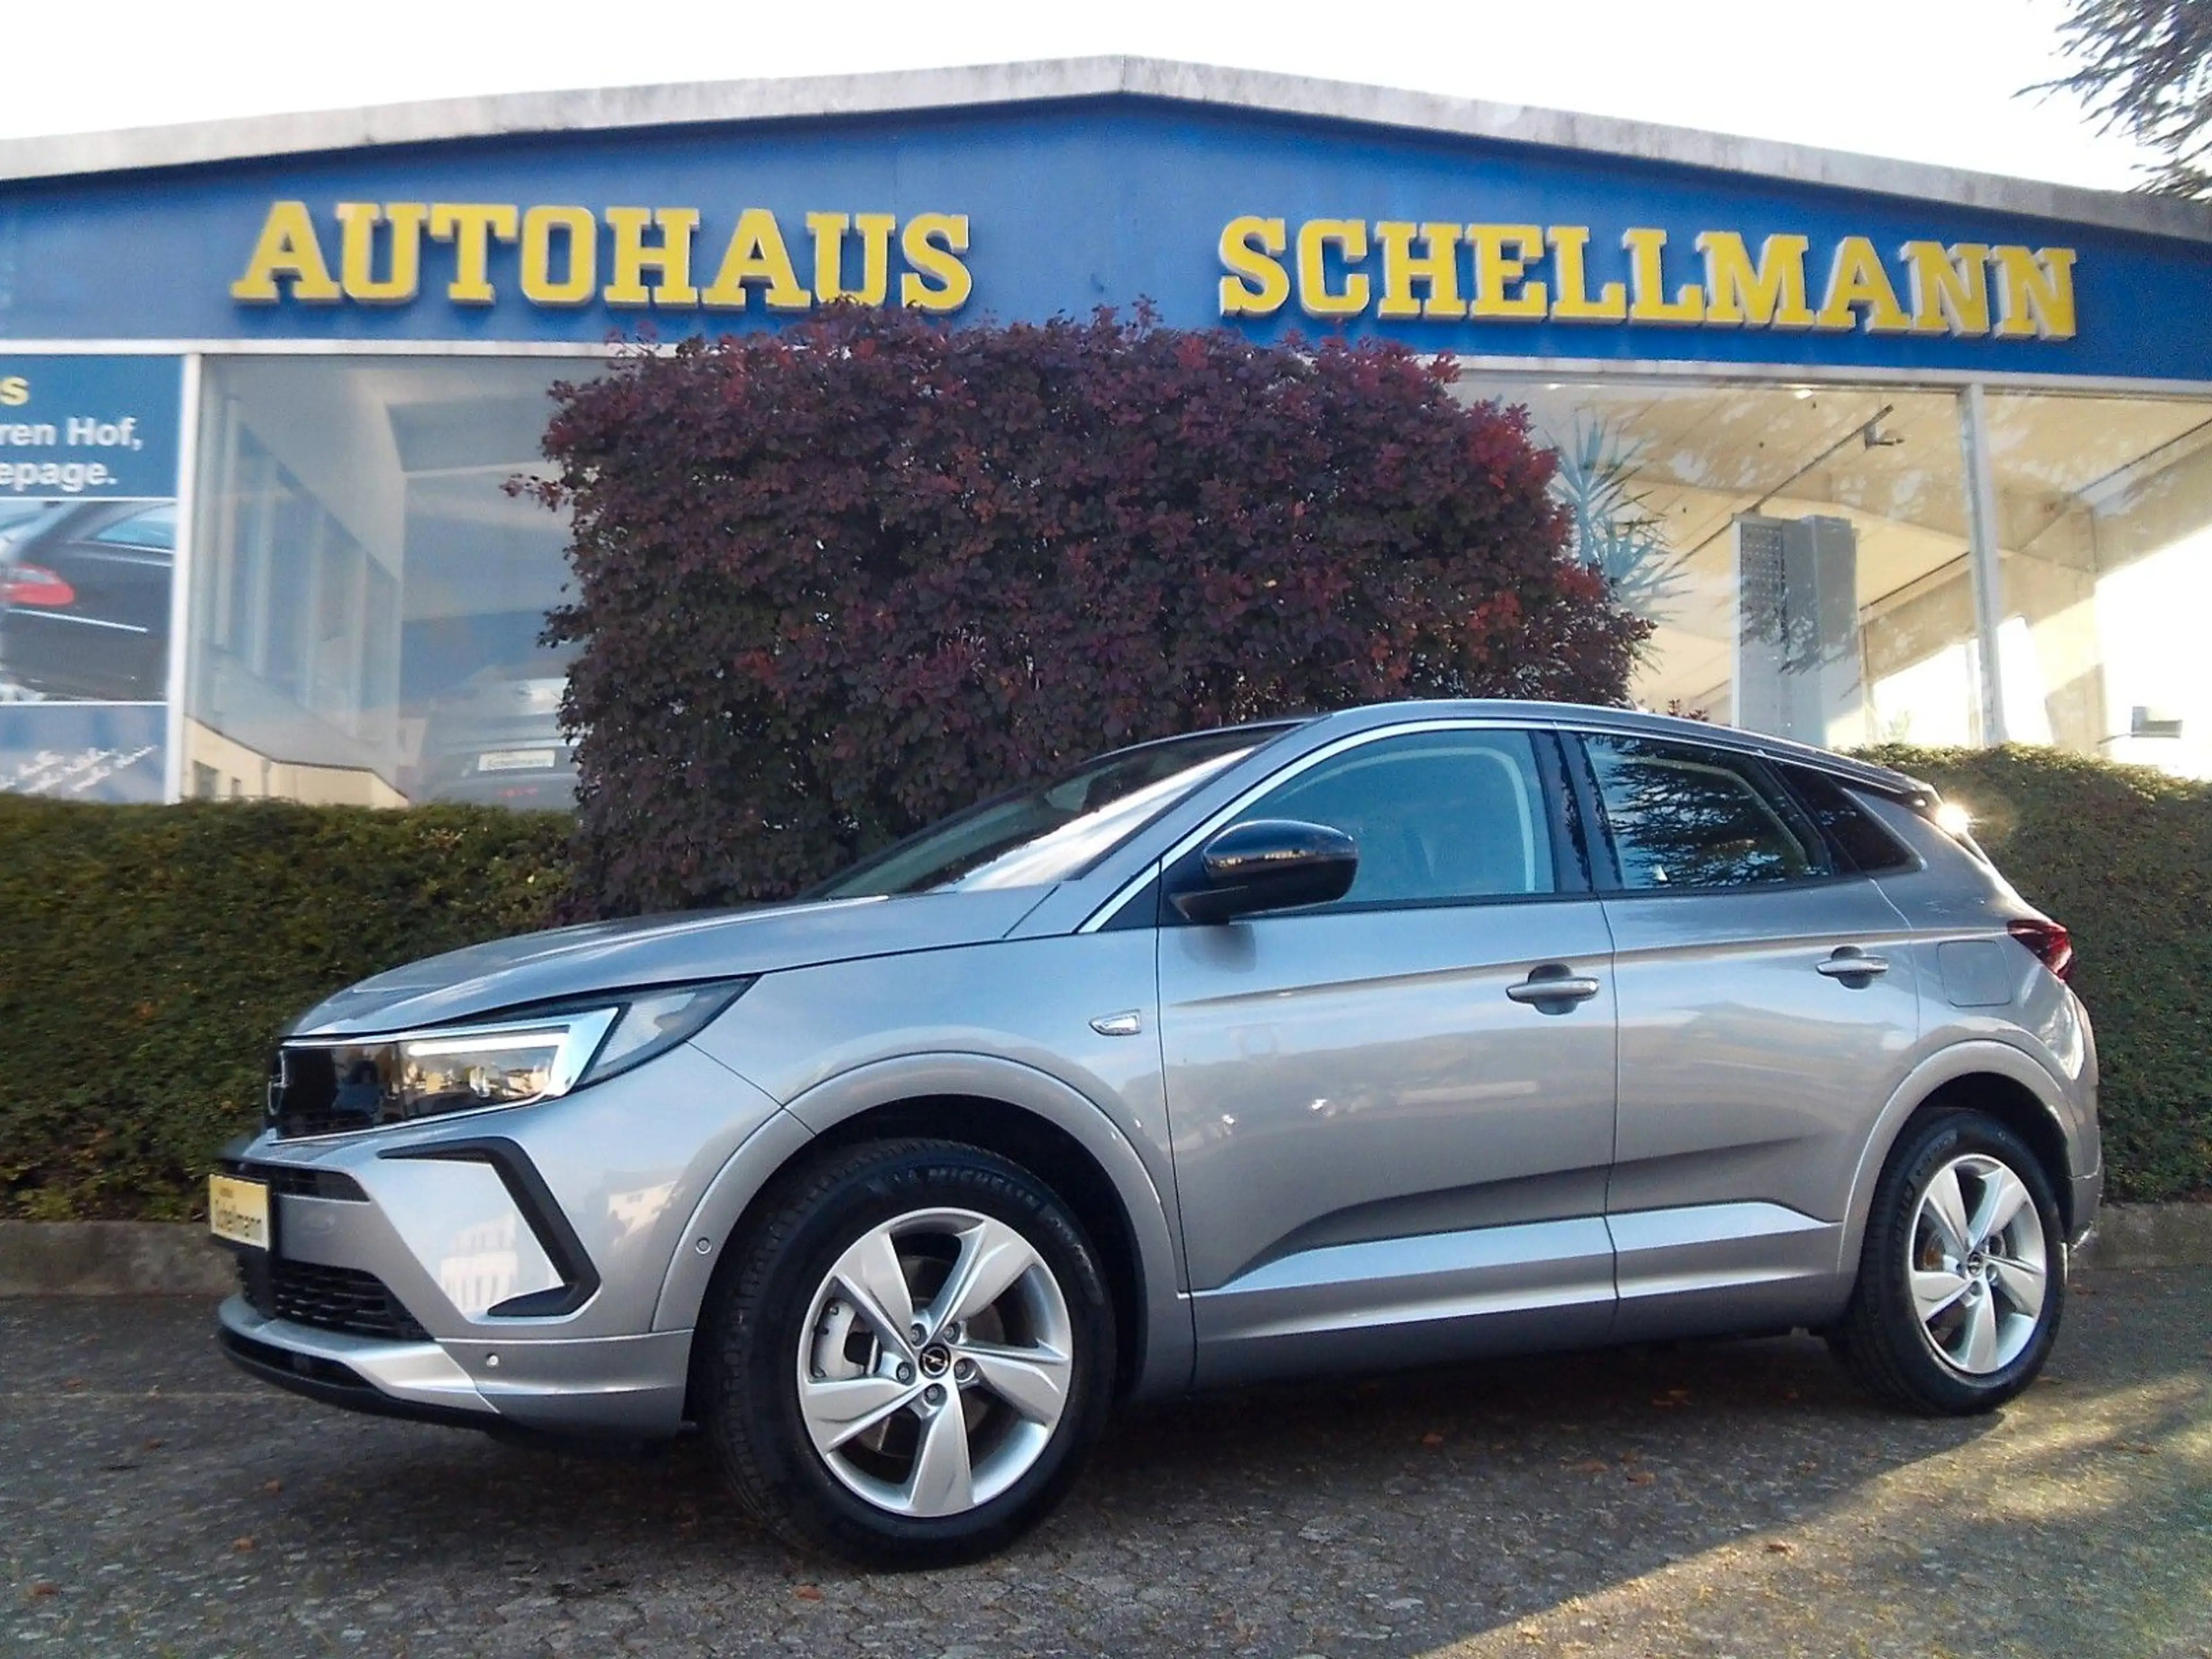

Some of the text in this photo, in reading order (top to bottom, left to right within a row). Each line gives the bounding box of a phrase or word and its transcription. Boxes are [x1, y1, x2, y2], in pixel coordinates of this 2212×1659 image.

[231, 200, 2077, 341] AUTOHAUS SCHELLMANN
[66, 416, 143, 451] Hof,
[0, 463, 118, 492] epage.
